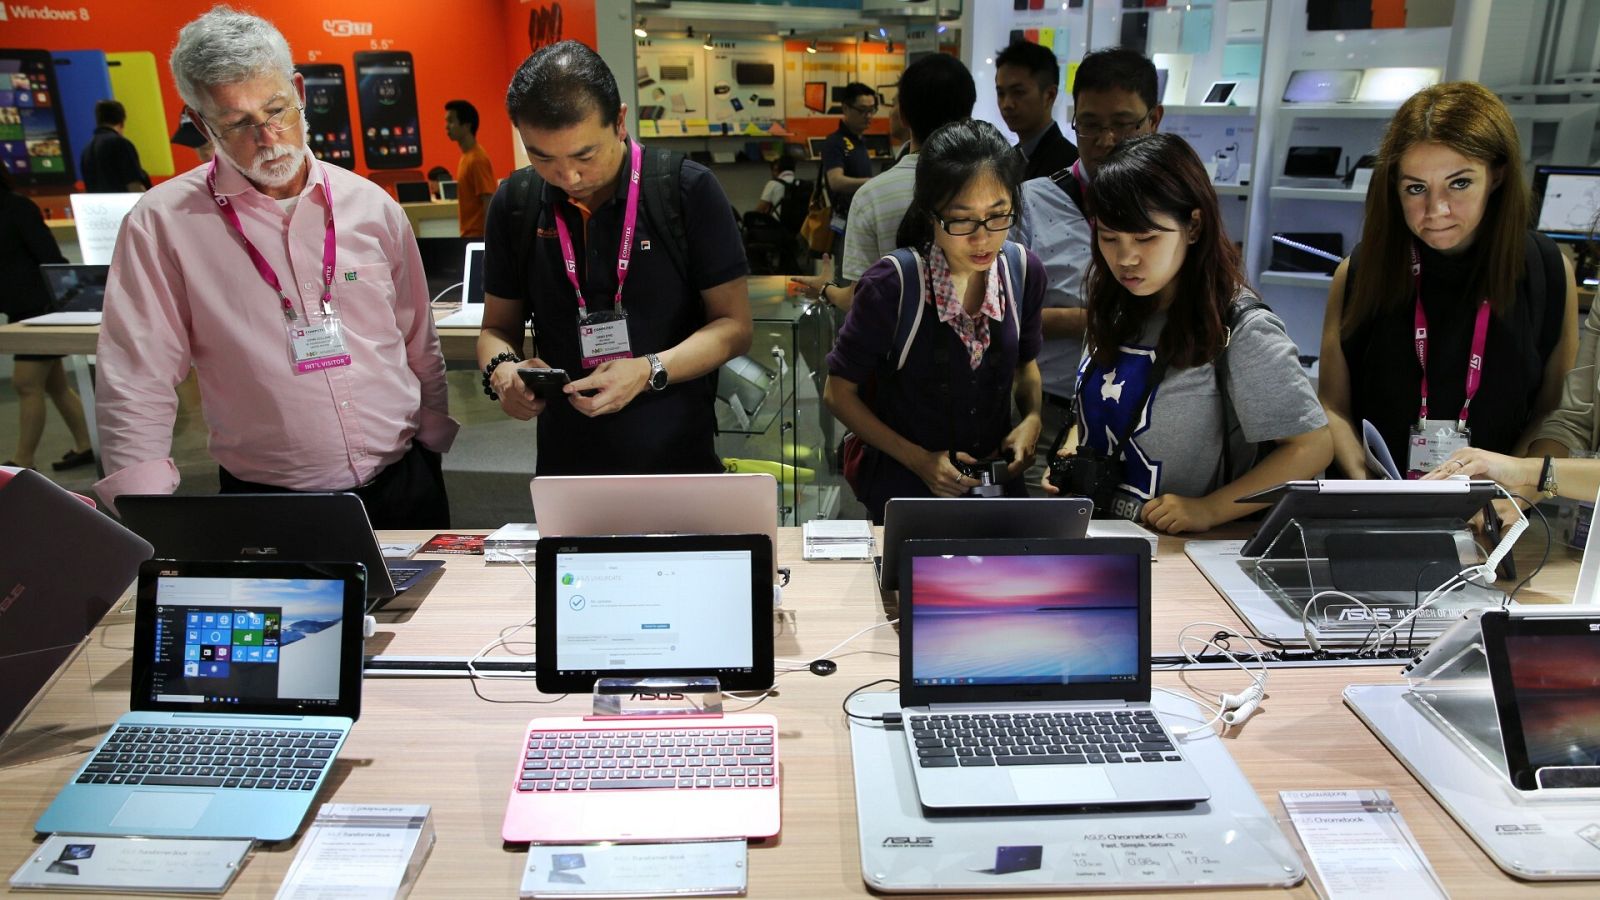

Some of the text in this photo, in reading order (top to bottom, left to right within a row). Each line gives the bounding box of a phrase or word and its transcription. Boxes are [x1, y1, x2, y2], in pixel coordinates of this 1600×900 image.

[9, 5, 91, 21] Windows 8
[322, 358, 345, 367] VISITOR
[1338, 607, 1393, 621] ASUS
[882, 836, 936, 844] ASUS
